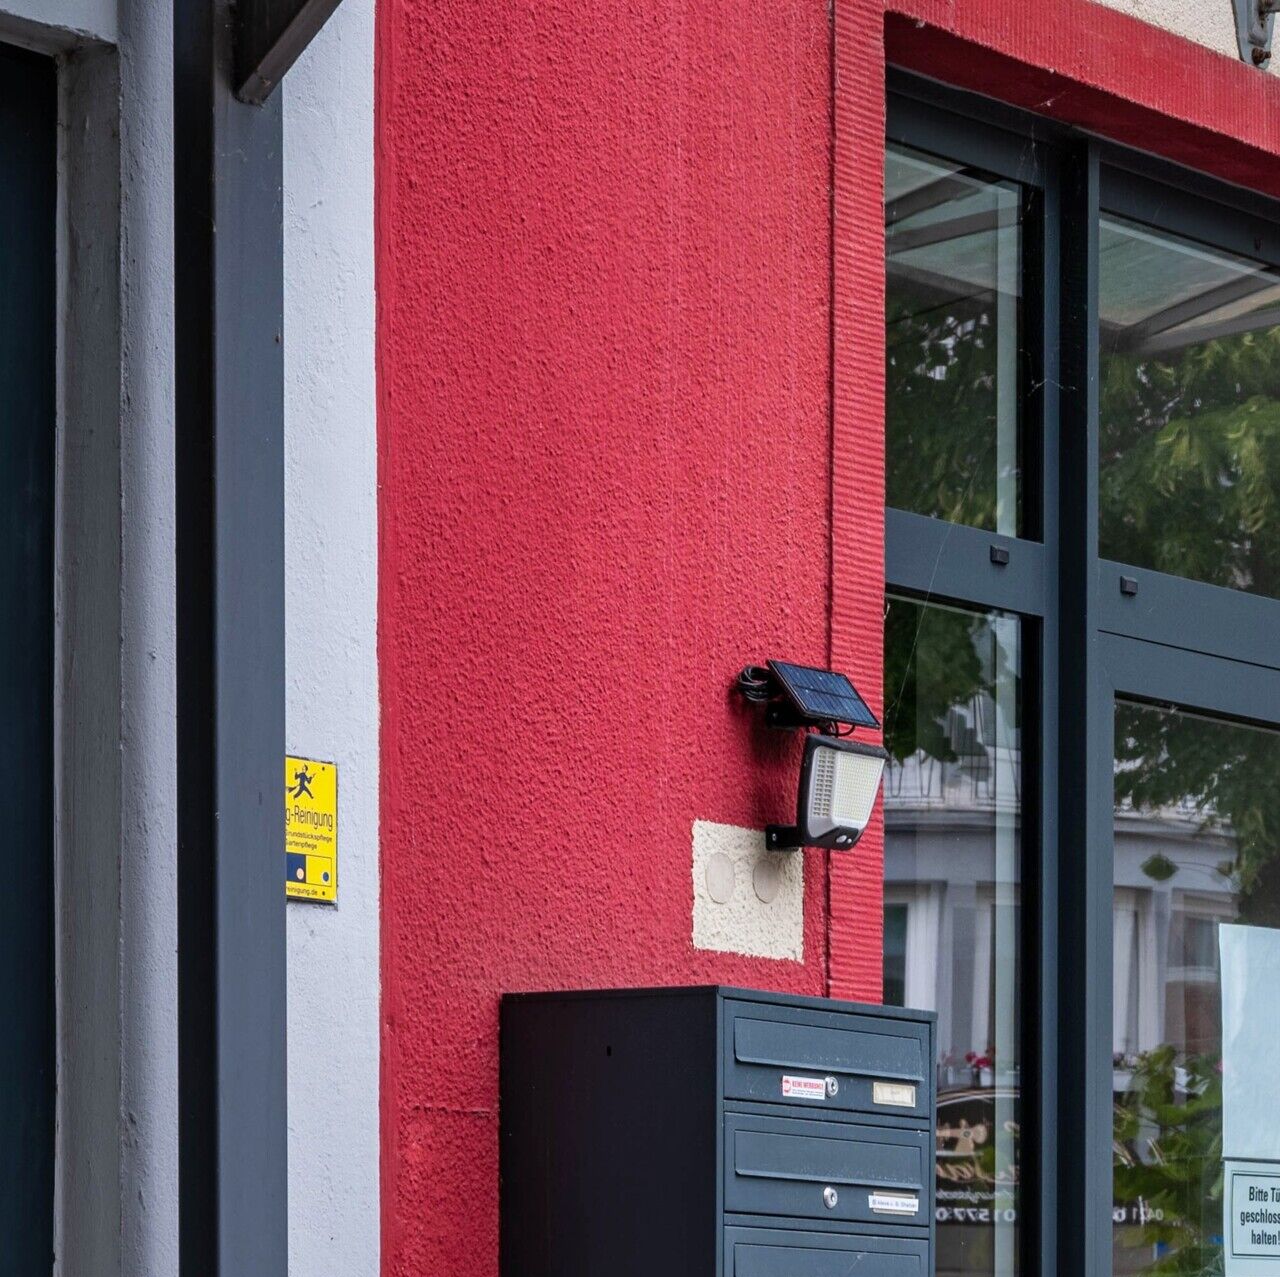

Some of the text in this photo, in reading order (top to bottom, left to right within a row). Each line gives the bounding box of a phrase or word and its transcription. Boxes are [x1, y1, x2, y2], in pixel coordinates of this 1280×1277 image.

[286, 830, 333, 843] rundstückspflege
[286, 839, 318, 851] artenpflege
[1249, 1186, 1268, 1202] Bitte
[1251, 1229, 1280, 1245] halten!
